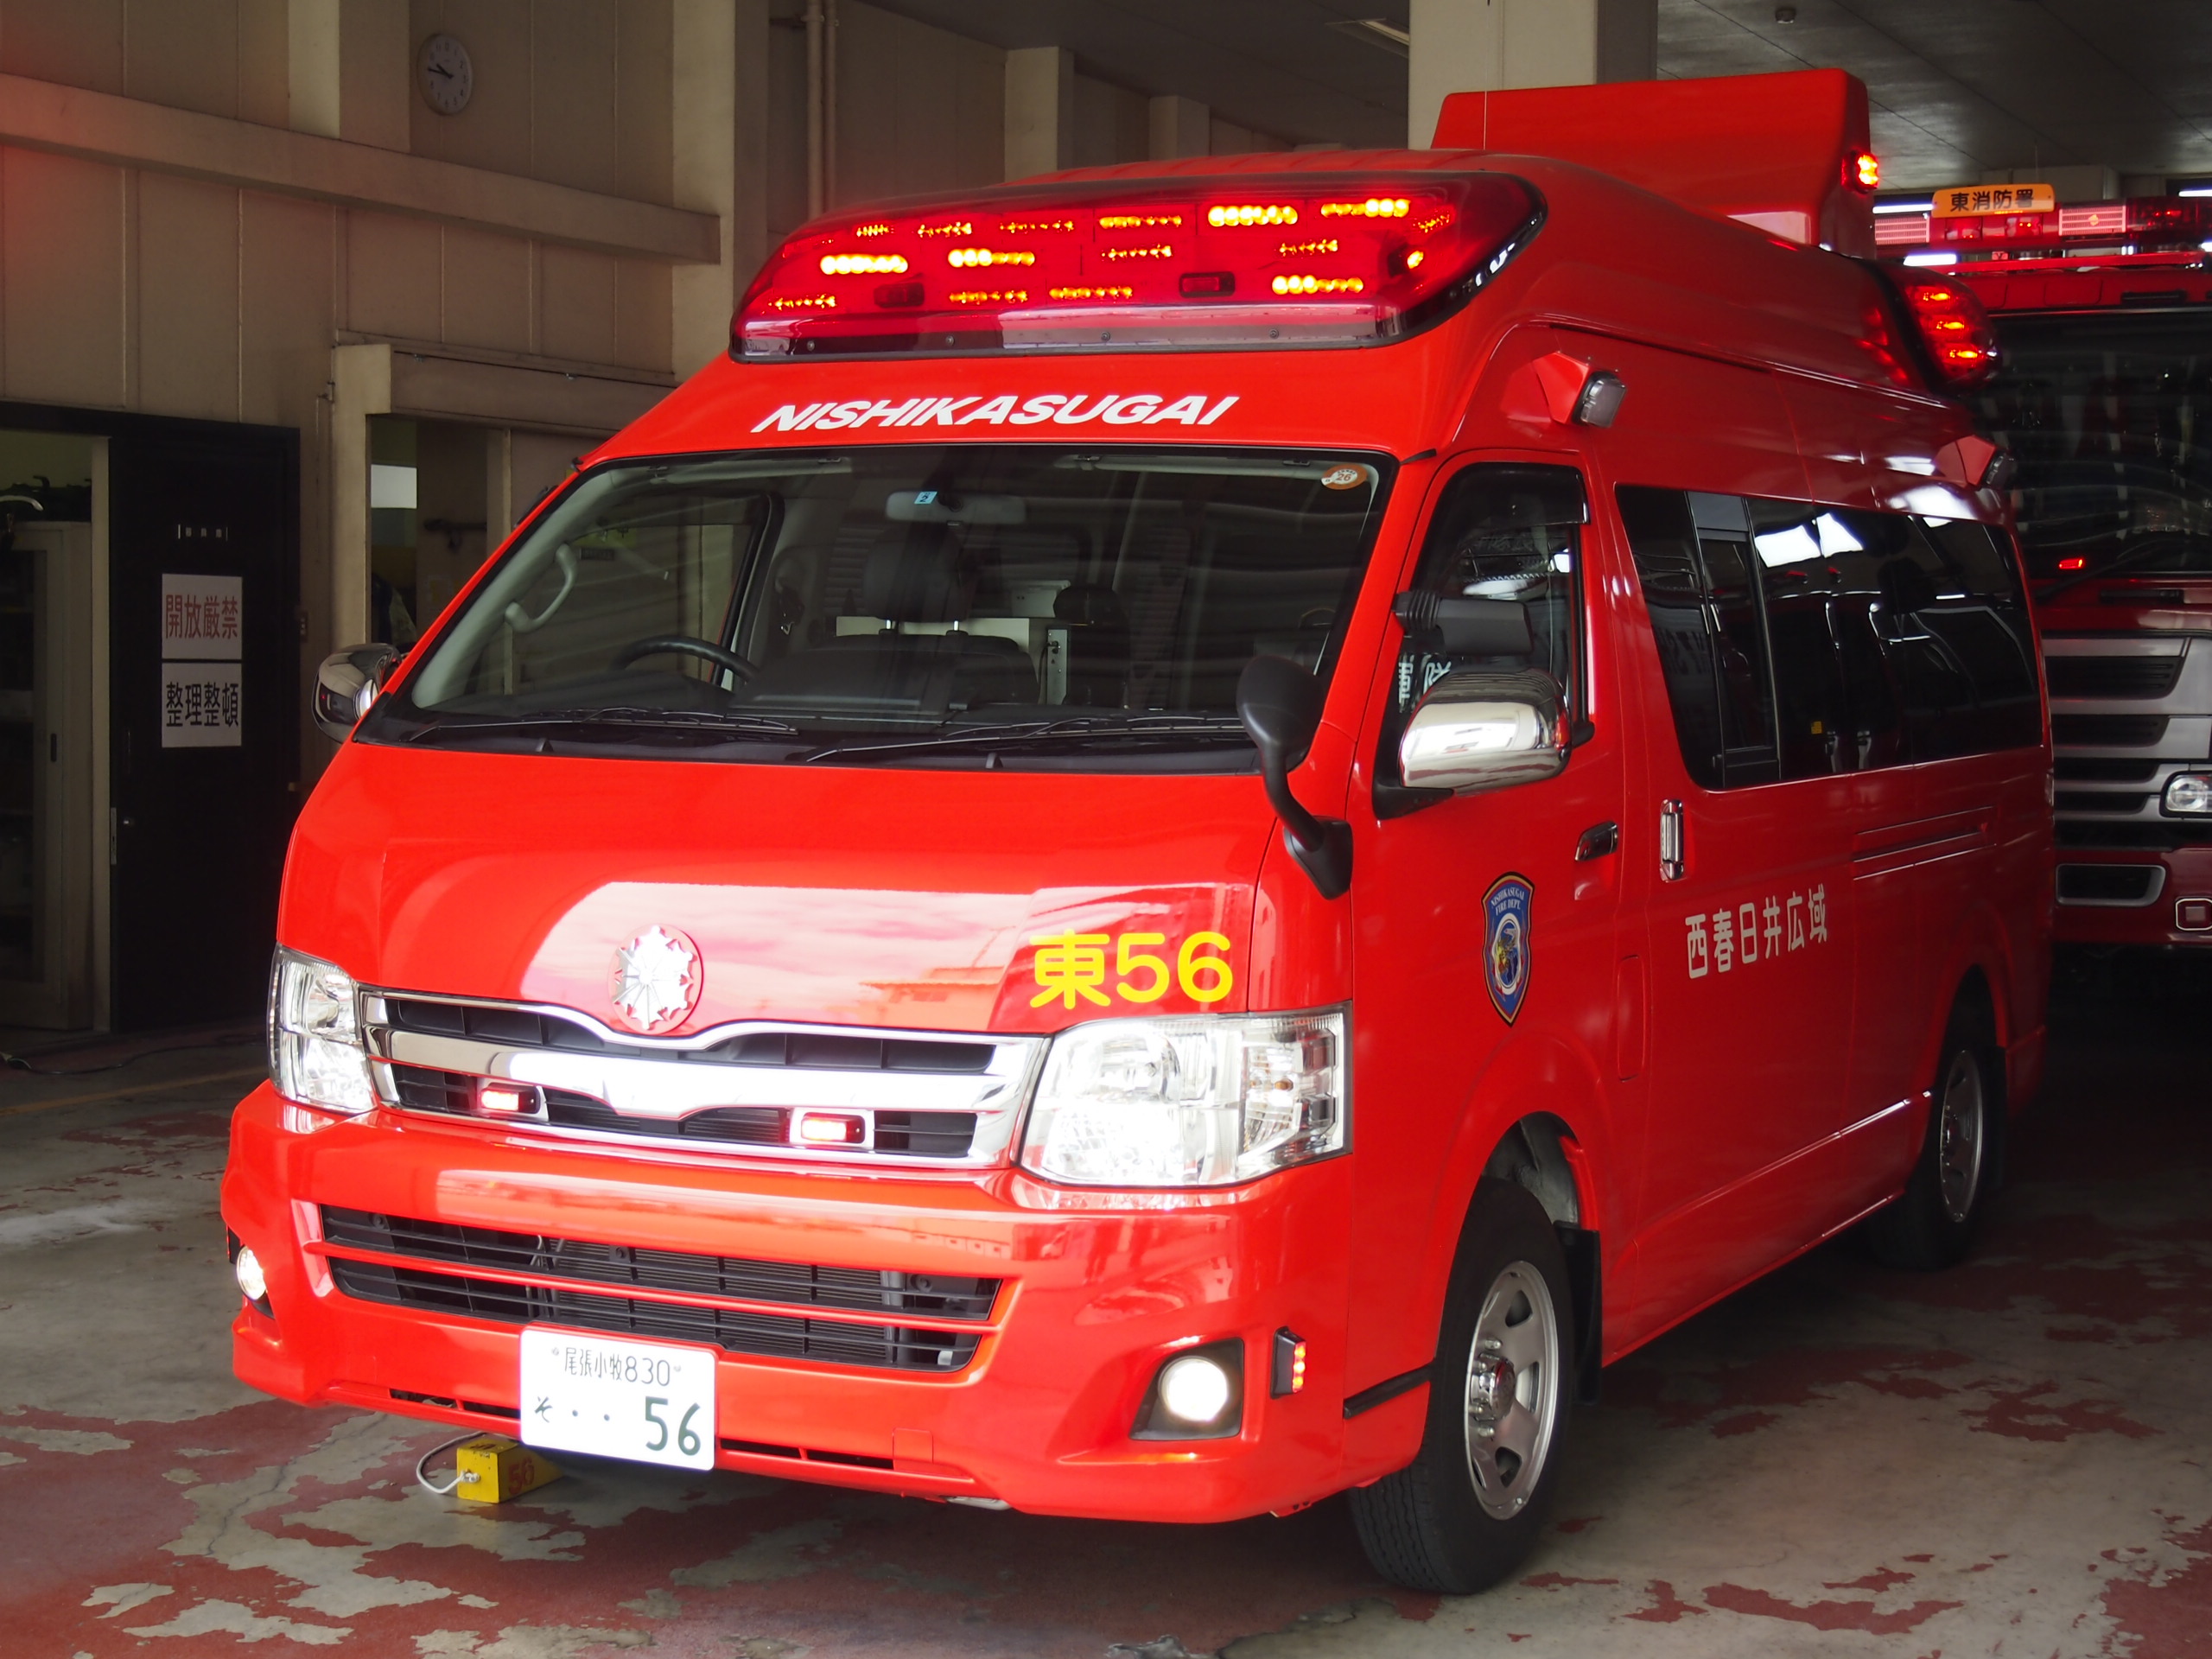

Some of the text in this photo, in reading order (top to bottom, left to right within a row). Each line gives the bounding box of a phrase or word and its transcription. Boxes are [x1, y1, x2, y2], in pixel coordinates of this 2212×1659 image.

[1950, 188, 2034, 213] 東消防署
[750, 395, 1240, 433] NISHIKASUGAI
[165, 594, 238, 639] 開放厳禁
[166, 682, 238, 728] 整理整頓
[1685, 883, 1827, 979] 西春日井広域
[1029, 928, 1233, 1009] 東56
[509, 1456, 534, 1495] 56
